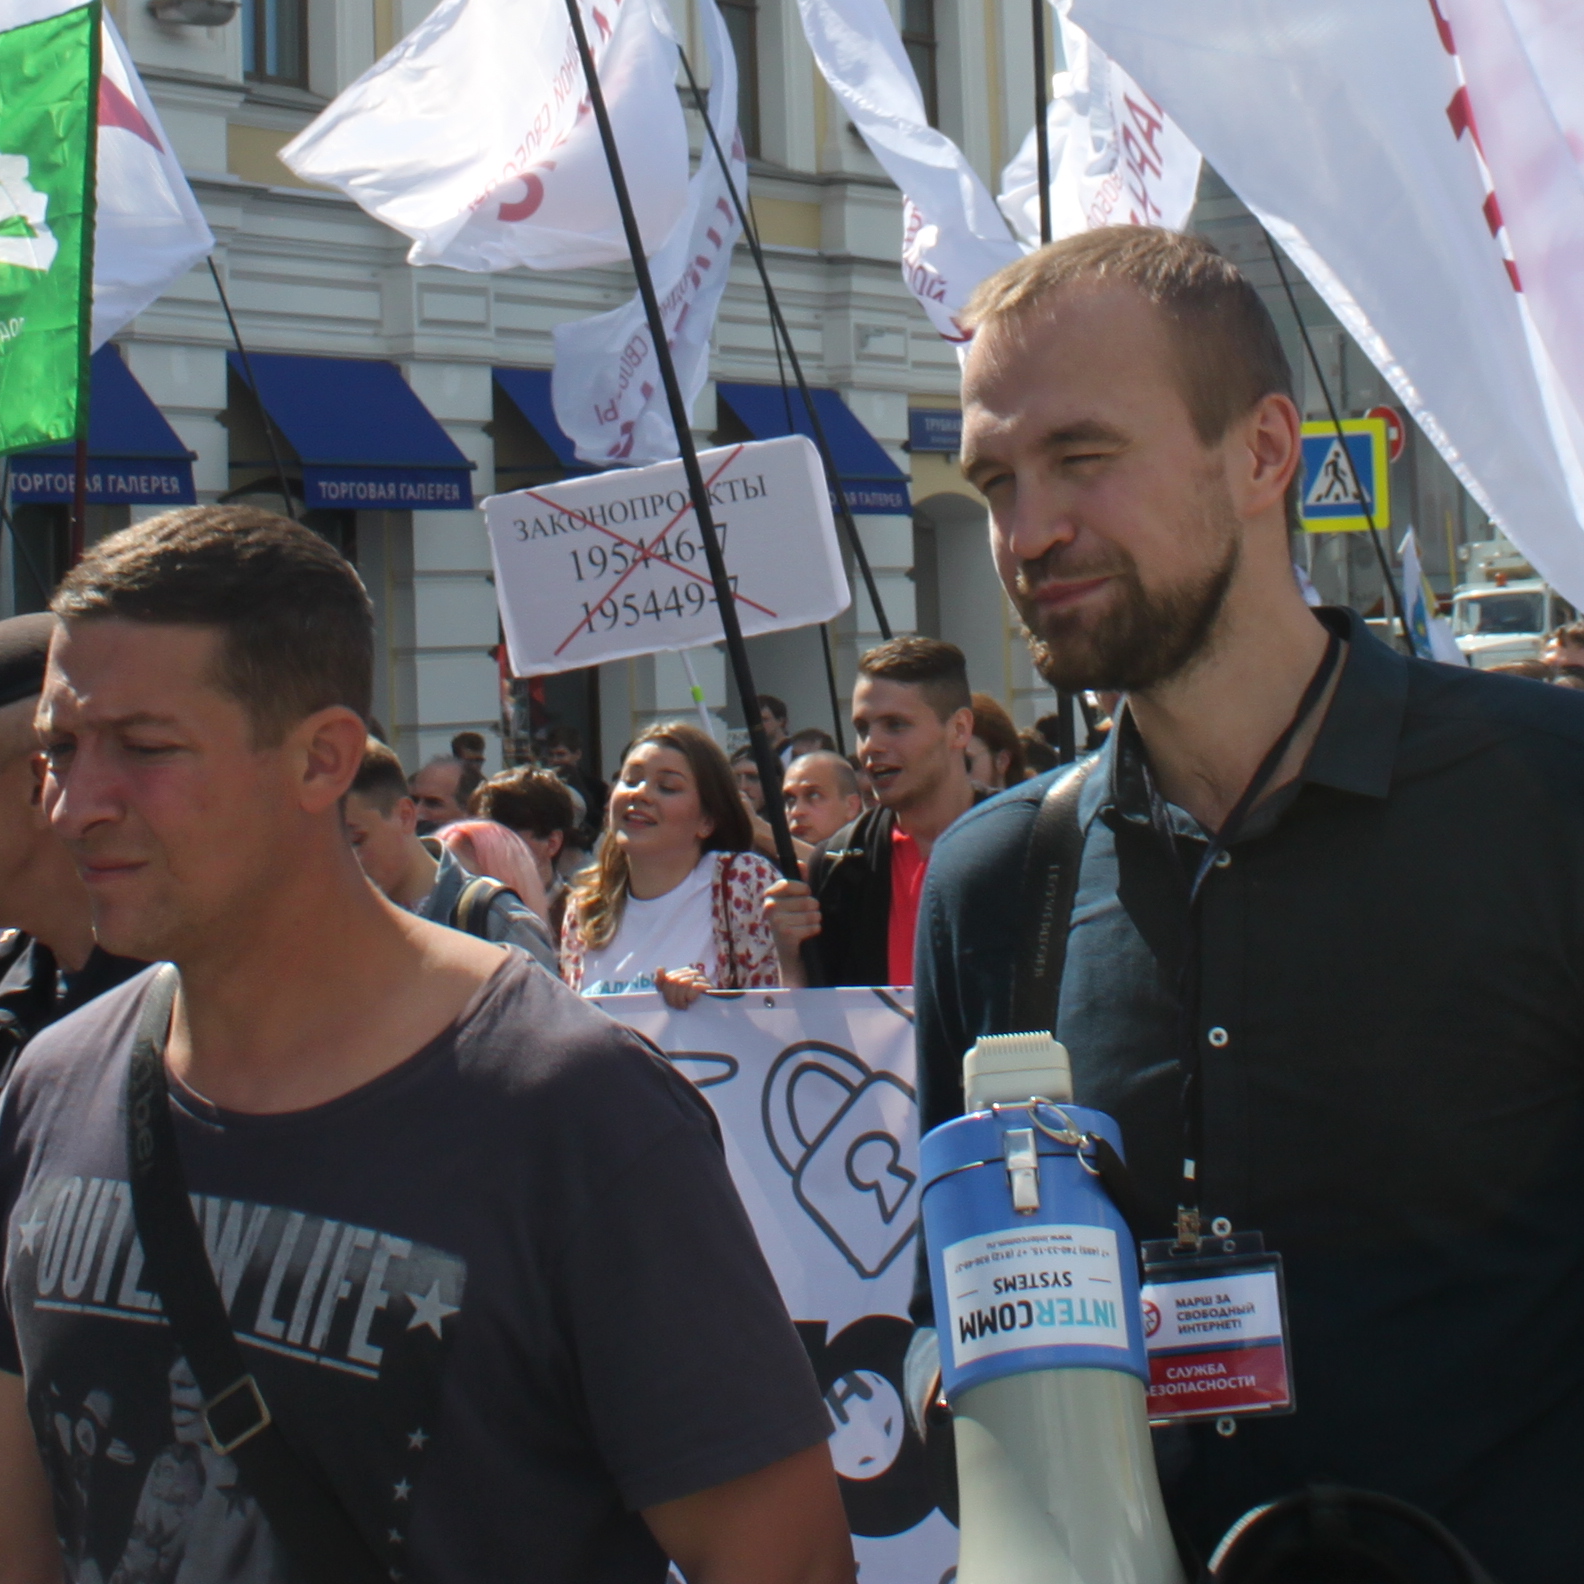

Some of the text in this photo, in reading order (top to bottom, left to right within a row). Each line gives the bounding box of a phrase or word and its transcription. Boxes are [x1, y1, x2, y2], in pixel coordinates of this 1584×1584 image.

[107, 475, 181, 495] ГАЛЕРЕЯ
[317, 480, 461, 502] ТОРГОВАЯ ГАЛЕРЕЯ
[514, 475, 768, 543] ЗАКОНОПРОКТЫ
[254, 1211, 413, 1367] LIFE
[993, 1271, 1073, 1295] SYSTEMS
[1174, 1293, 1232, 1308] МАРШ ЗА
[959, 1297, 1118, 1344] INTERCOMM
[1177, 1302, 1256, 1322] СВОБОДНЫЙ
[1177, 1318, 1242, 1335] ИНТЕРНЕТ!
[1166, 1362, 1228, 1380] СЛУЖБА
[1147, 1375, 1257, 1397] ЕЗОПАСНОСТИ
